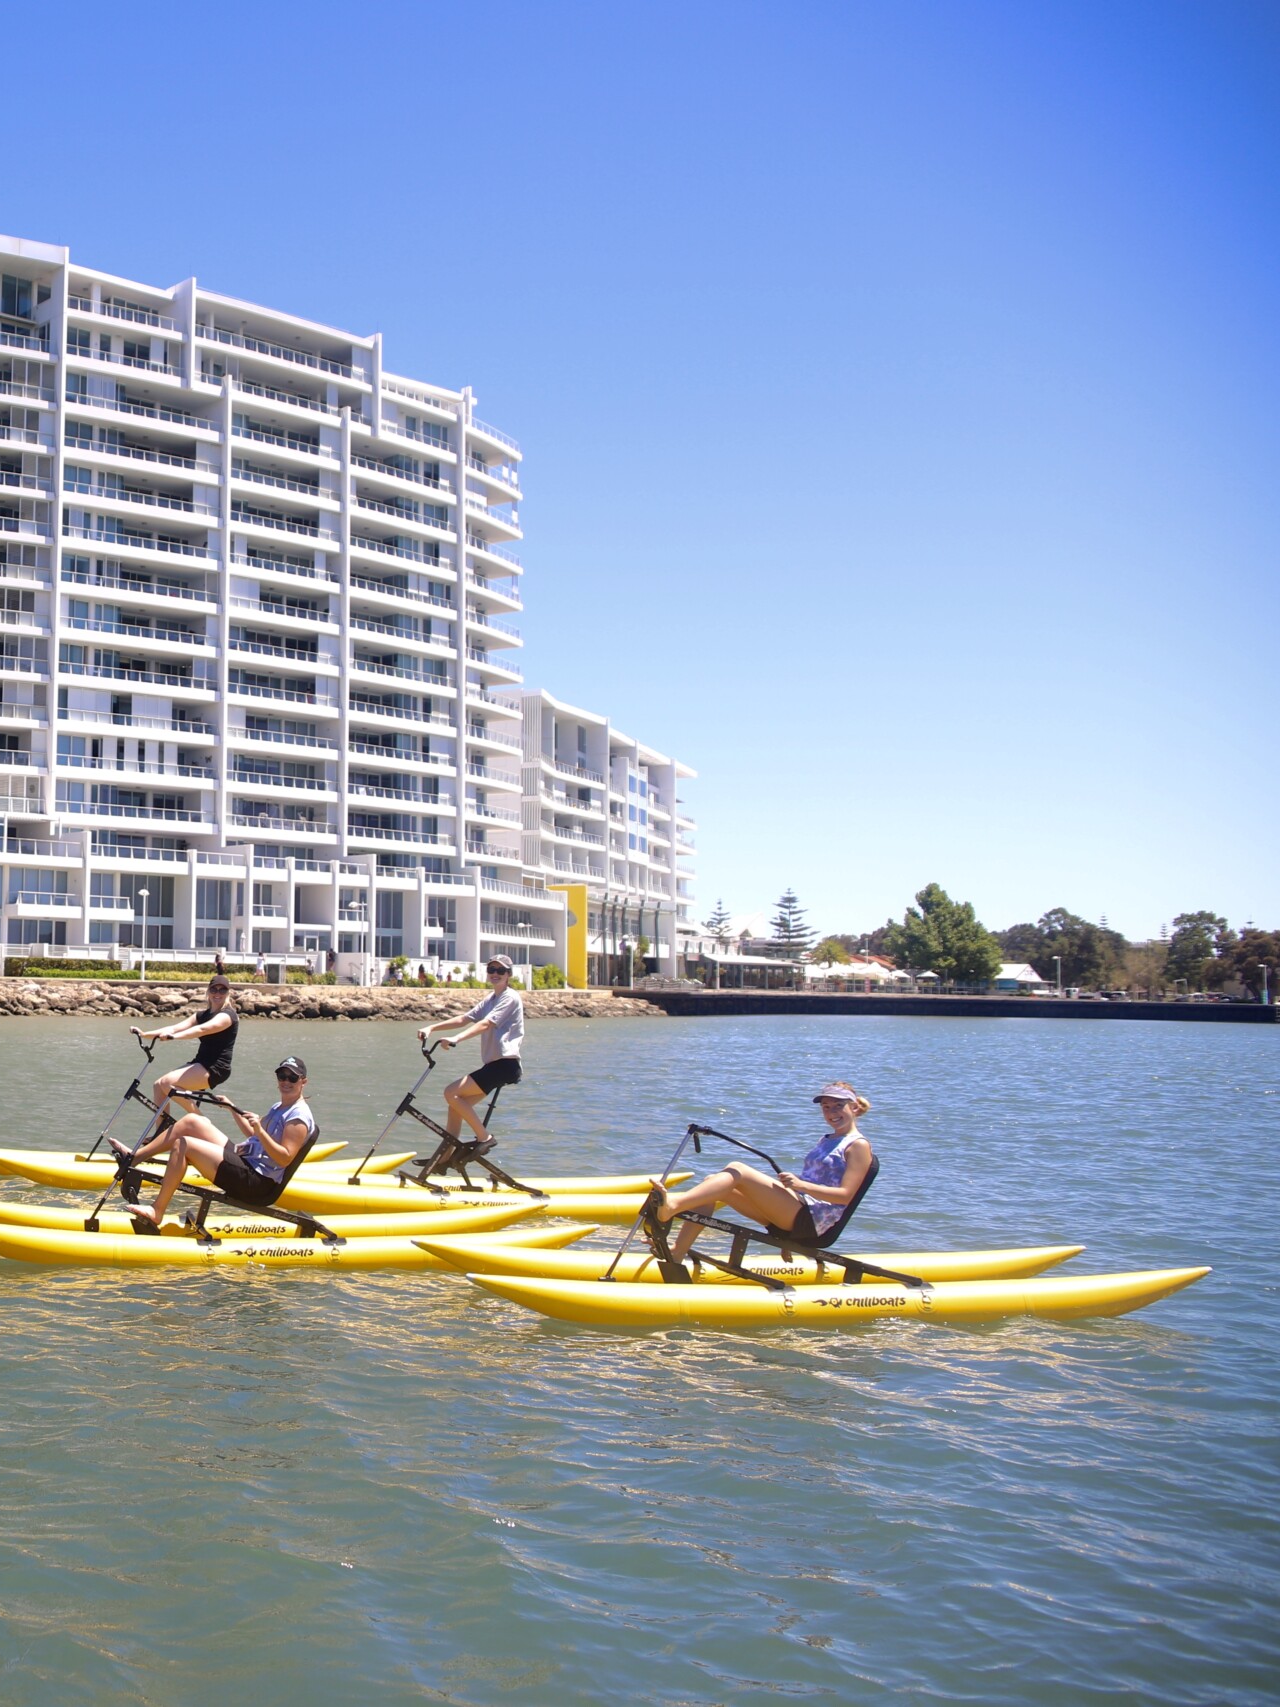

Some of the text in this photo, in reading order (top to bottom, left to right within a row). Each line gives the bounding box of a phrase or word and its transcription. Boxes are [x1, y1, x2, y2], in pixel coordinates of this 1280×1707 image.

[236, 1223, 286, 1234] chiliboats
[699, 1216, 732, 1231] chiliboats
[260, 1246, 314, 1257] chiliboats
[749, 1266, 804, 1276] chiliboats
[846, 1296, 906, 1307] chiliboats
